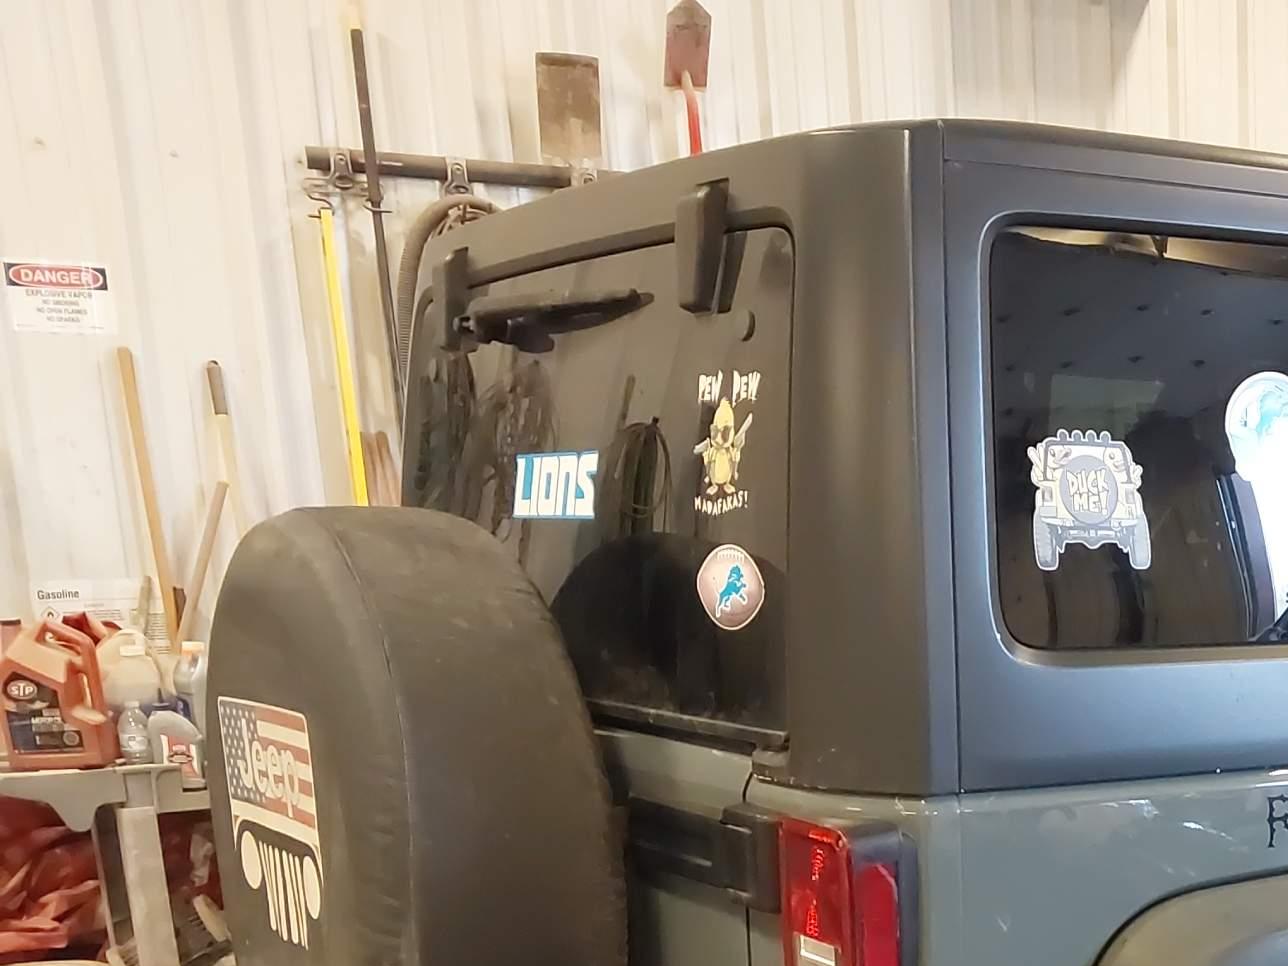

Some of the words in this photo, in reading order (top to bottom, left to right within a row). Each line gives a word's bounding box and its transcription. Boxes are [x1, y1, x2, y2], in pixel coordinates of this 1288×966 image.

[20, 269, 93, 287] DANGER
[698, 370, 723, 404] PEW
[732, 370, 761, 407] PEW
[513, 450, 599, 519] LIONS
[1066, 468, 1109, 497] DUCK
[694, 490, 748, 516] MADAFAKAS!
[1073, 490, 1108, 515] ME!
[37, 589, 80, 600] Gasoline
[10, 683, 34, 697] STP
[238, 717, 299, 818] Jeep
